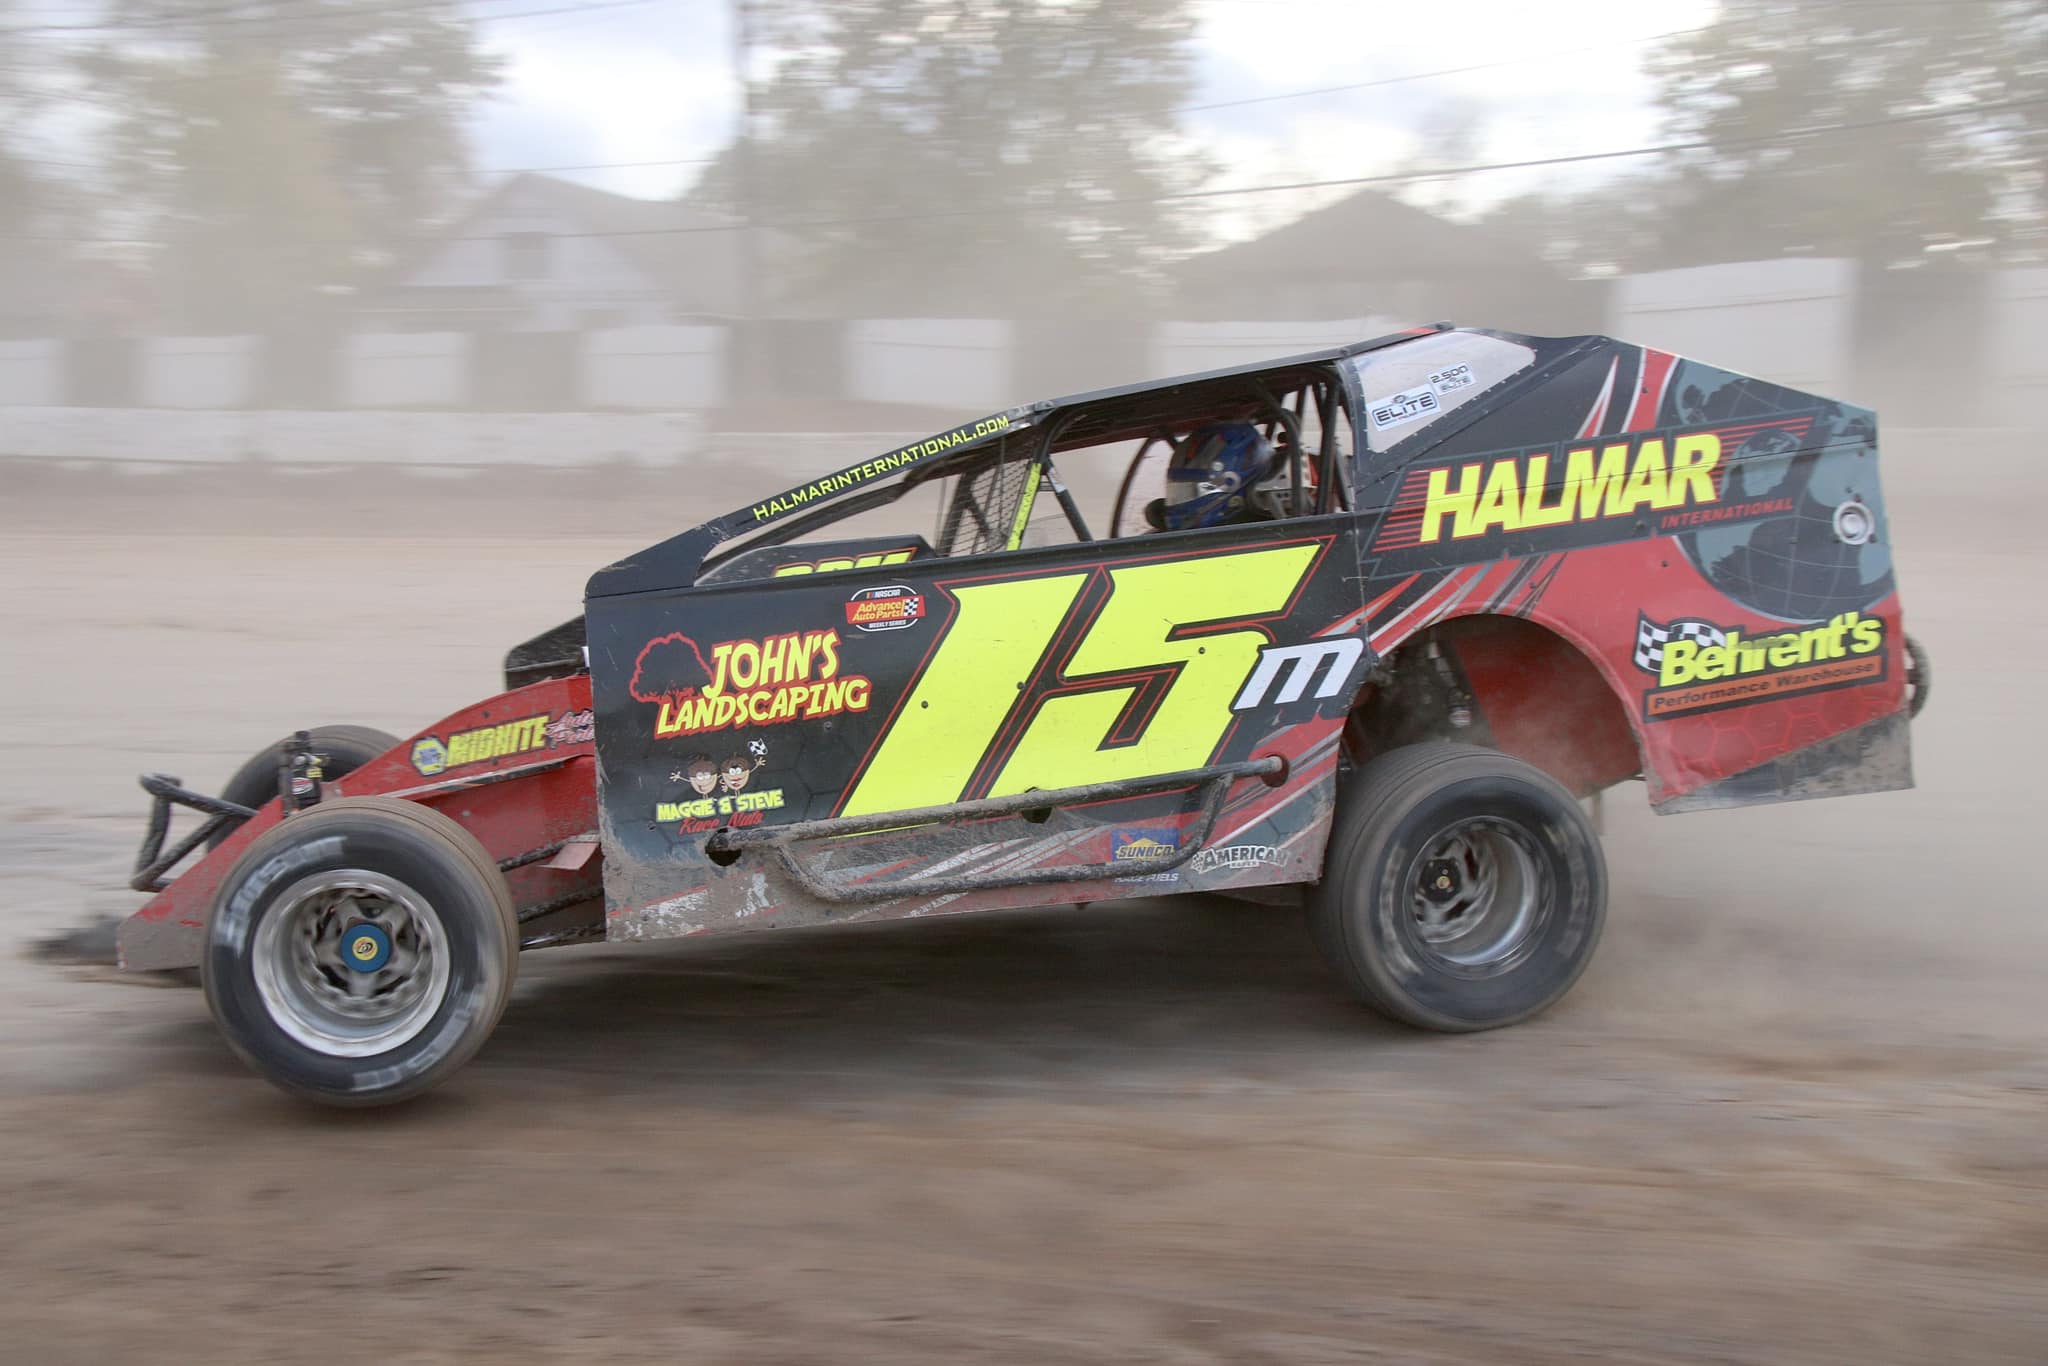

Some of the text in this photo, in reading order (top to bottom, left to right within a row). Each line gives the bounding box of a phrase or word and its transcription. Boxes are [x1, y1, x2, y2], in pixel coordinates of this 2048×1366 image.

[753, 416, 1009, 520] HALMARINTERNATIONAL.COM
[1419, 433, 1722, 543] HALMAR
[1660, 498, 1793, 529] INTERNATIONAL
[852, 609, 901, 621] Auto Parts
[858, 601, 902, 612] Advance
[702, 631, 839, 699] JOHN'S
[1659, 612, 1882, 687] Behrent's
[1653, 662, 1875, 710] Performance Warehouse
[656, 679, 869, 735] LANDSCAPING
[656, 788, 785, 822] MAGGIE & STEVE
[678, 816, 720, 836] Race
[1118, 846, 1173, 858] SUNOCO
[1203, 846, 1287, 869] AMERICAN
